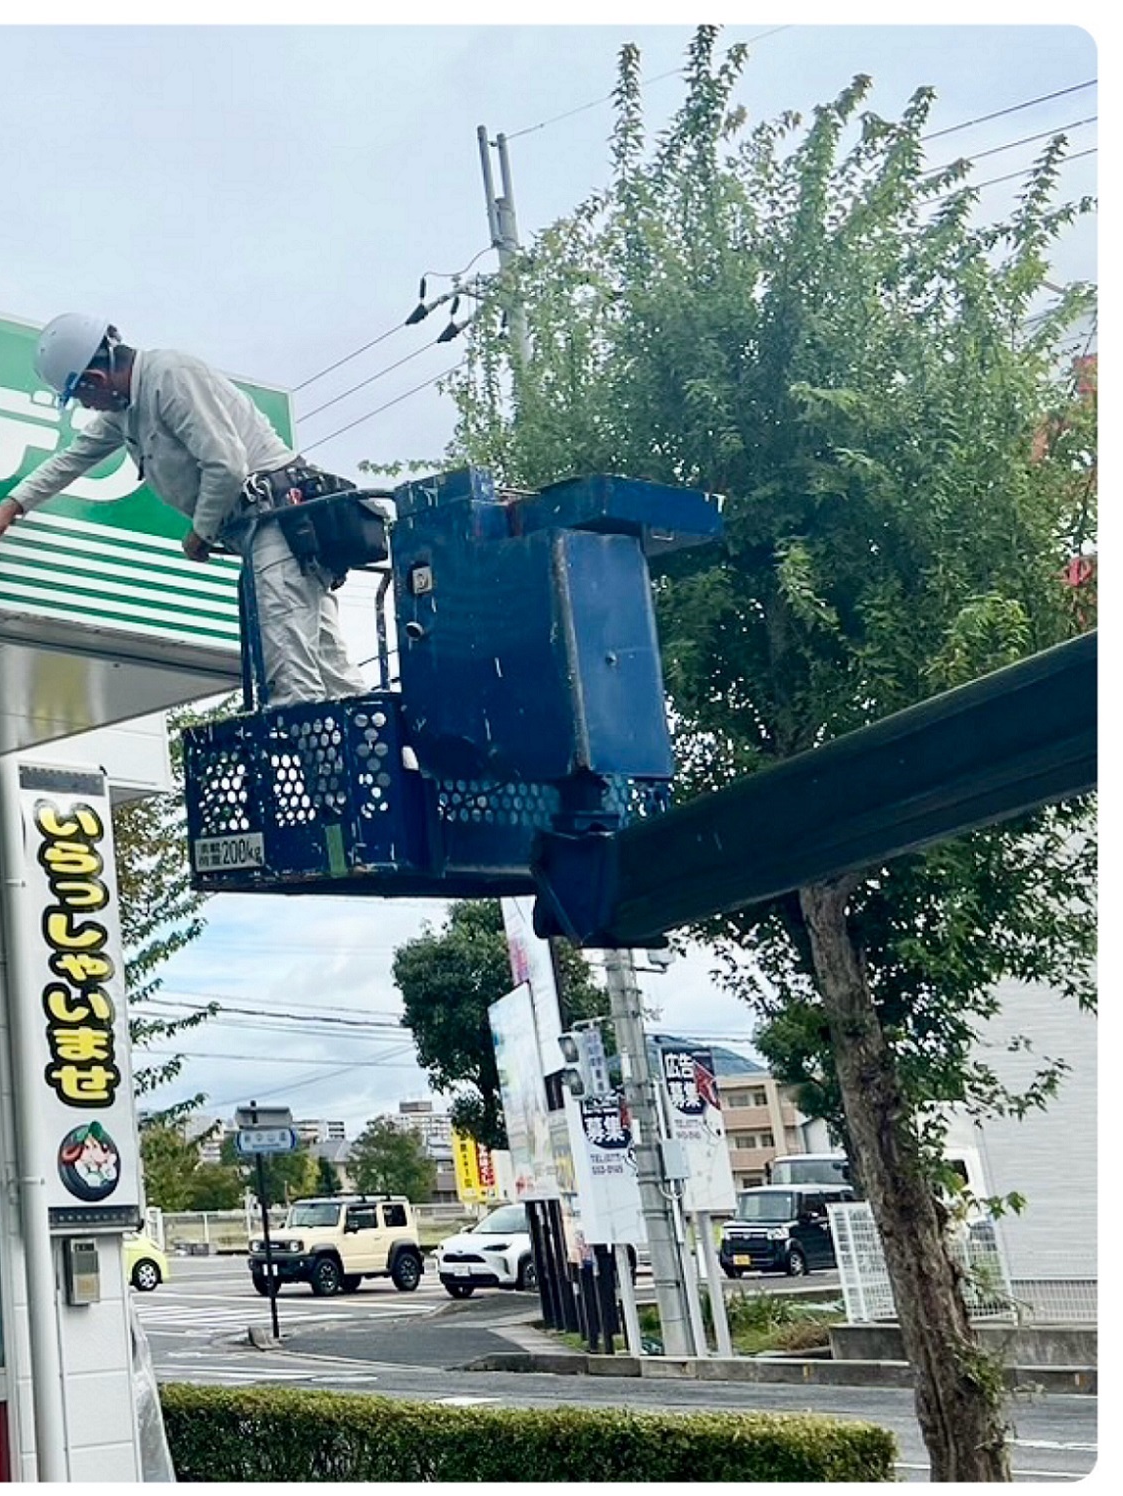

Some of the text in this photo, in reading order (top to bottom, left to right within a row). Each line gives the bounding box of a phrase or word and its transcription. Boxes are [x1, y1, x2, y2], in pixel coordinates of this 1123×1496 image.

[36, 801, 121, 1107] いらっしゃいませ
